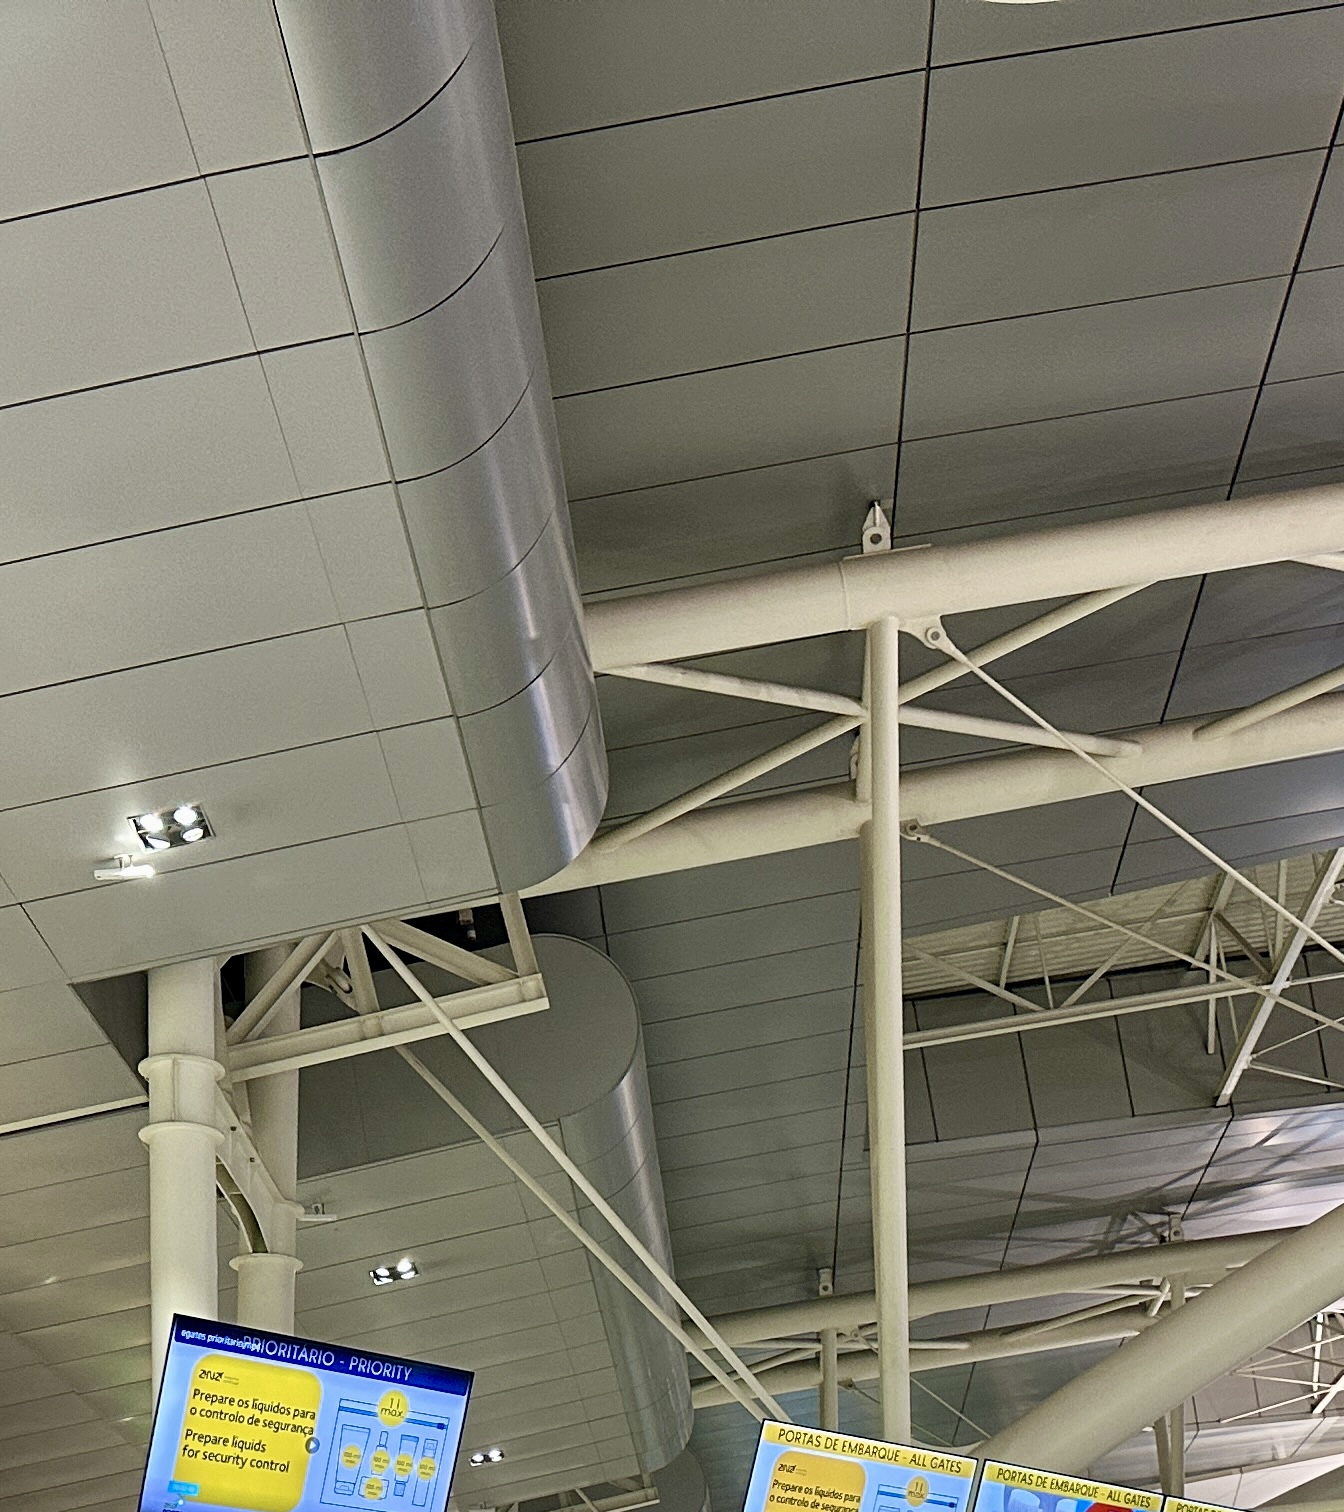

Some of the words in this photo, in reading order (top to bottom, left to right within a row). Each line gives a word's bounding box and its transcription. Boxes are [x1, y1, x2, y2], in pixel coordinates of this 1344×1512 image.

[348, 1356, 413, 1381] PRIORITY
[193, 1388, 235, 1406] Prepare
[237, 1398, 249, 1409] os
[292, 1408, 316, 1420] para
[189, 1406, 197, 1416] o
[199, 1408, 245, 1424] controlo
[247, 1414, 261, 1426] de
[262, 1419, 314, 1437] segurança
[185, 1428, 229, 1446] Prepare
[231, 1435, 267, 1453] liquids
[778, 1428, 822, 1448] PORTAS
[824, 1437, 838, 1451] DE
[841, 1440, 900, 1462] EMBARQUE
[908, 1452, 926, 1467] ALL
[930, 1456, 963, 1473] GATES
[182, 1444, 200, 1459] for
[201, 1450, 248, 1469] security
[249, 1458, 291, 1473] control
[768, 1494, 775, 1502] o
[776, 1495, 809, 1509] controlo
[810, 1499, 820, 1510] de
[771, 1479, 804, 1495] Prepare
[804, 1487, 814, 1496] os
[843, 1494, 861, 1504] para
[996, 1468, 1033, 1486] PORTAS
[1035, 1475, 1047, 1489] DE
[1049, 1478, 1099, 1499] EMBARQUE
[1106, 1489, 1122, 1503] ALL
[1124, 1492, 1151, 1509] GATES
